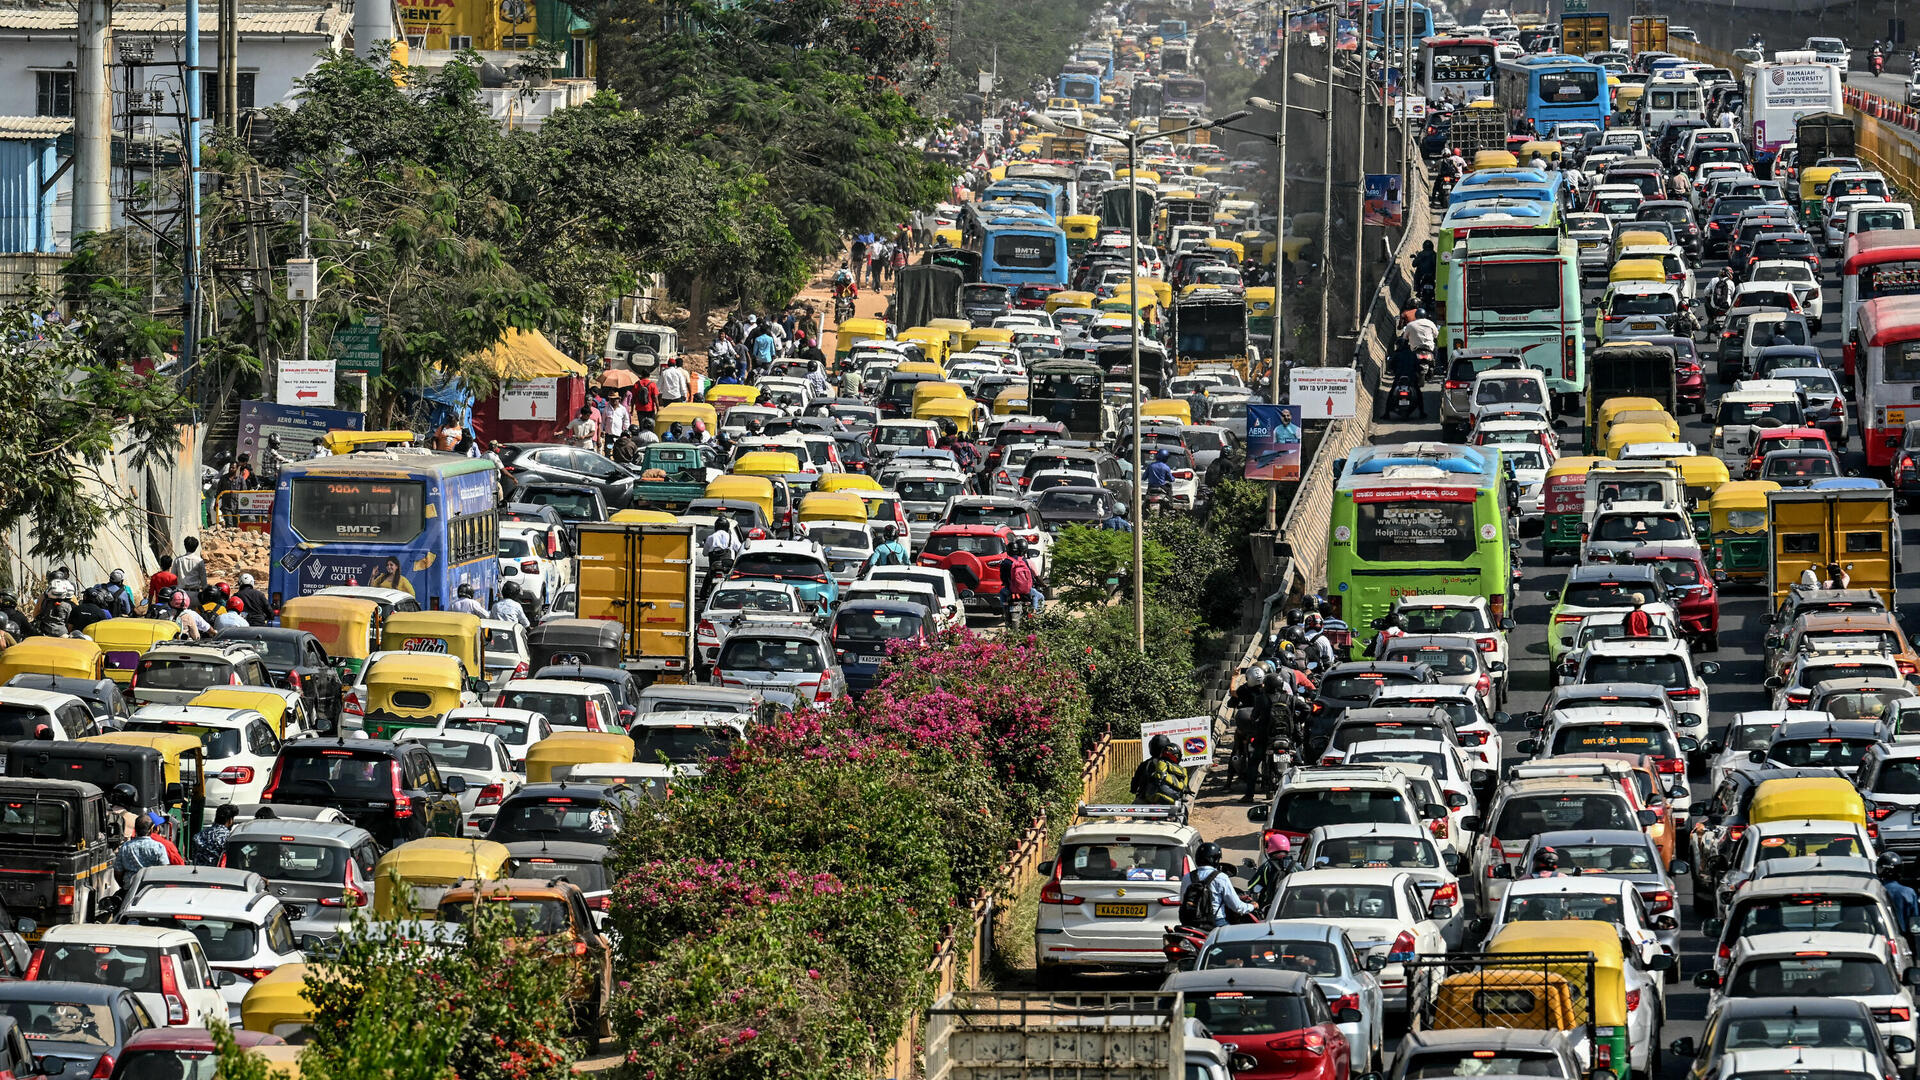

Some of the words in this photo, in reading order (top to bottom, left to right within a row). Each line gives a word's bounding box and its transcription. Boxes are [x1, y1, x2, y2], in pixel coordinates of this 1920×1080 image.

[1436, 71, 1486, 80] KSRT
[276, 416, 292, 424] AERO
[293, 417, 308, 425] INDIA
[312, 420, 327, 428] 2025
[1248, 427, 1267, 435] AERO
[336, 525, 382, 533] BMTC
[1375, 529, 1409, 538] Helpline
[1411, 528, 1458, 537] No.:155220
[331, 566, 363, 574] WHITE
[403, 639, 446, 654] Sultan
